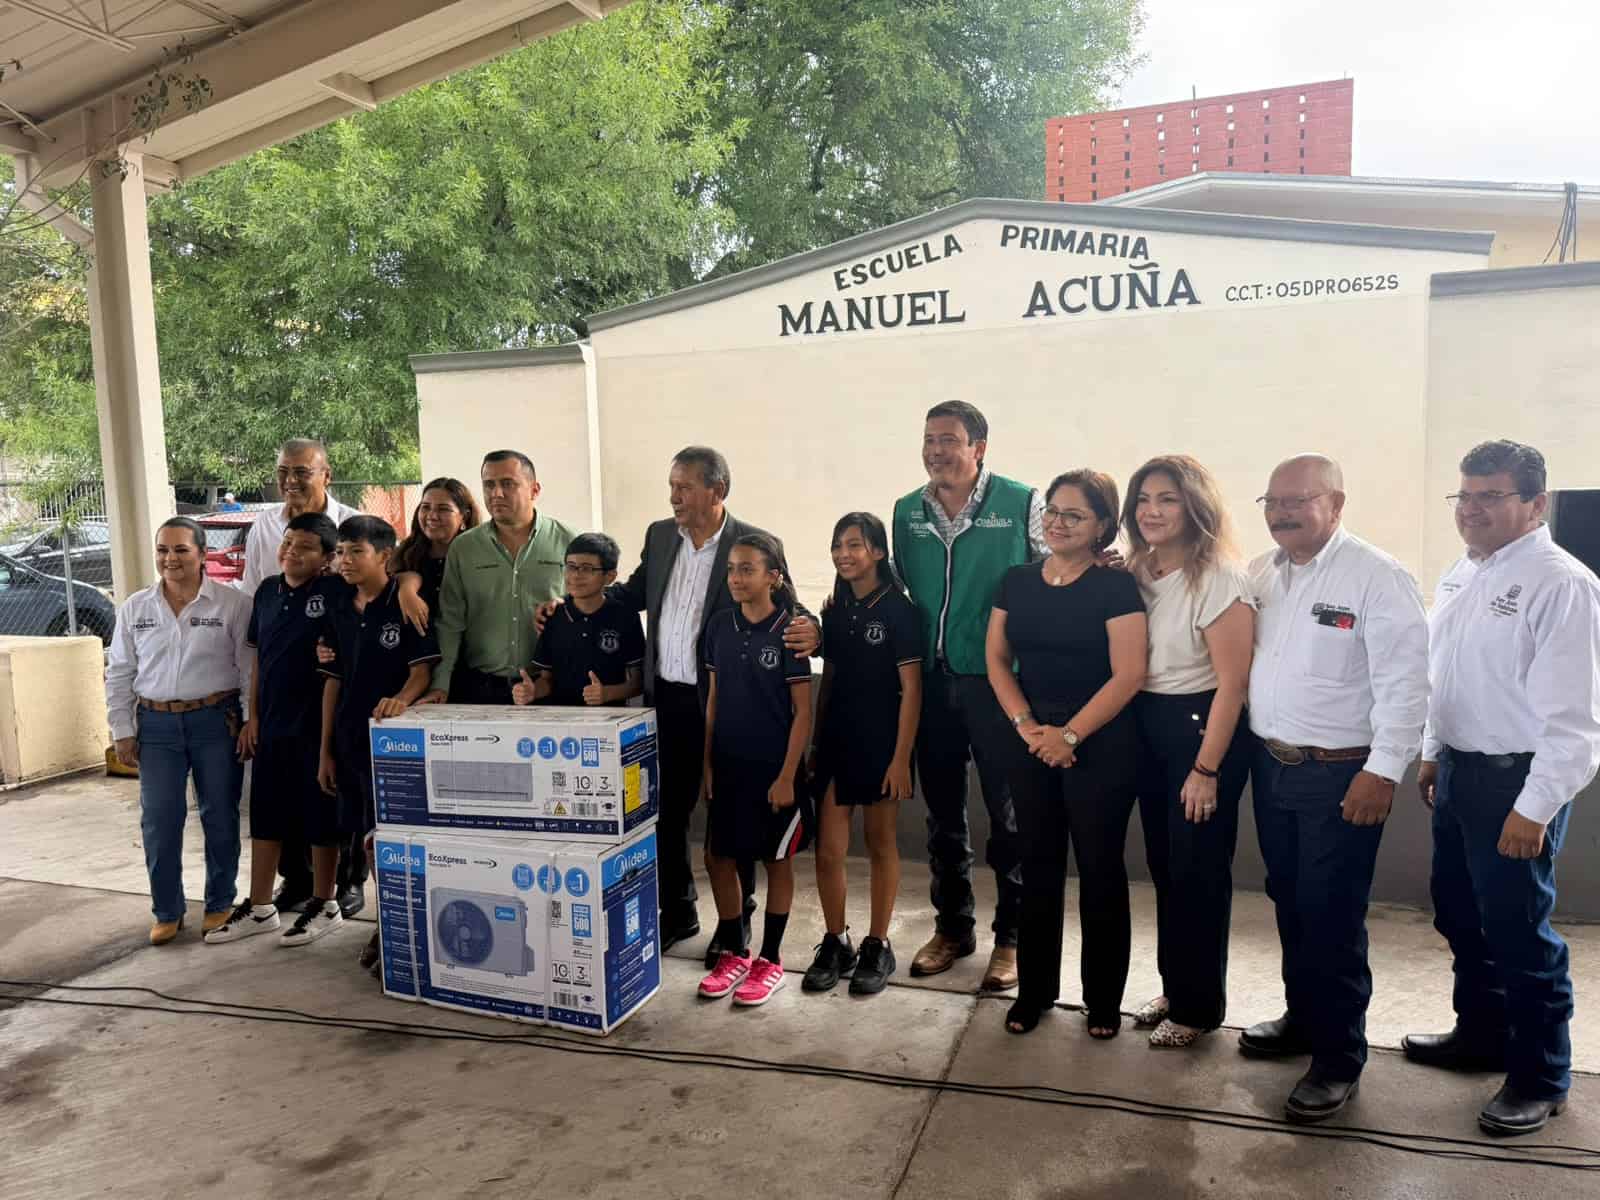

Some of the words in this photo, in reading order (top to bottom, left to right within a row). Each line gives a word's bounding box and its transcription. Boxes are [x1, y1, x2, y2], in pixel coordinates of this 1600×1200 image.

[834, 234, 963, 291] ESCUELA
[1000, 224, 1150, 261] PRIMARIA
[777, 290, 966, 337] MANUEL
[1022, 262, 1201, 318] ACUÑA
[379, 736, 418, 753] Midea
[600, 776, 609, 790] 3
[614, 848, 648, 878] Midea
[577, 966, 586, 981] 3
